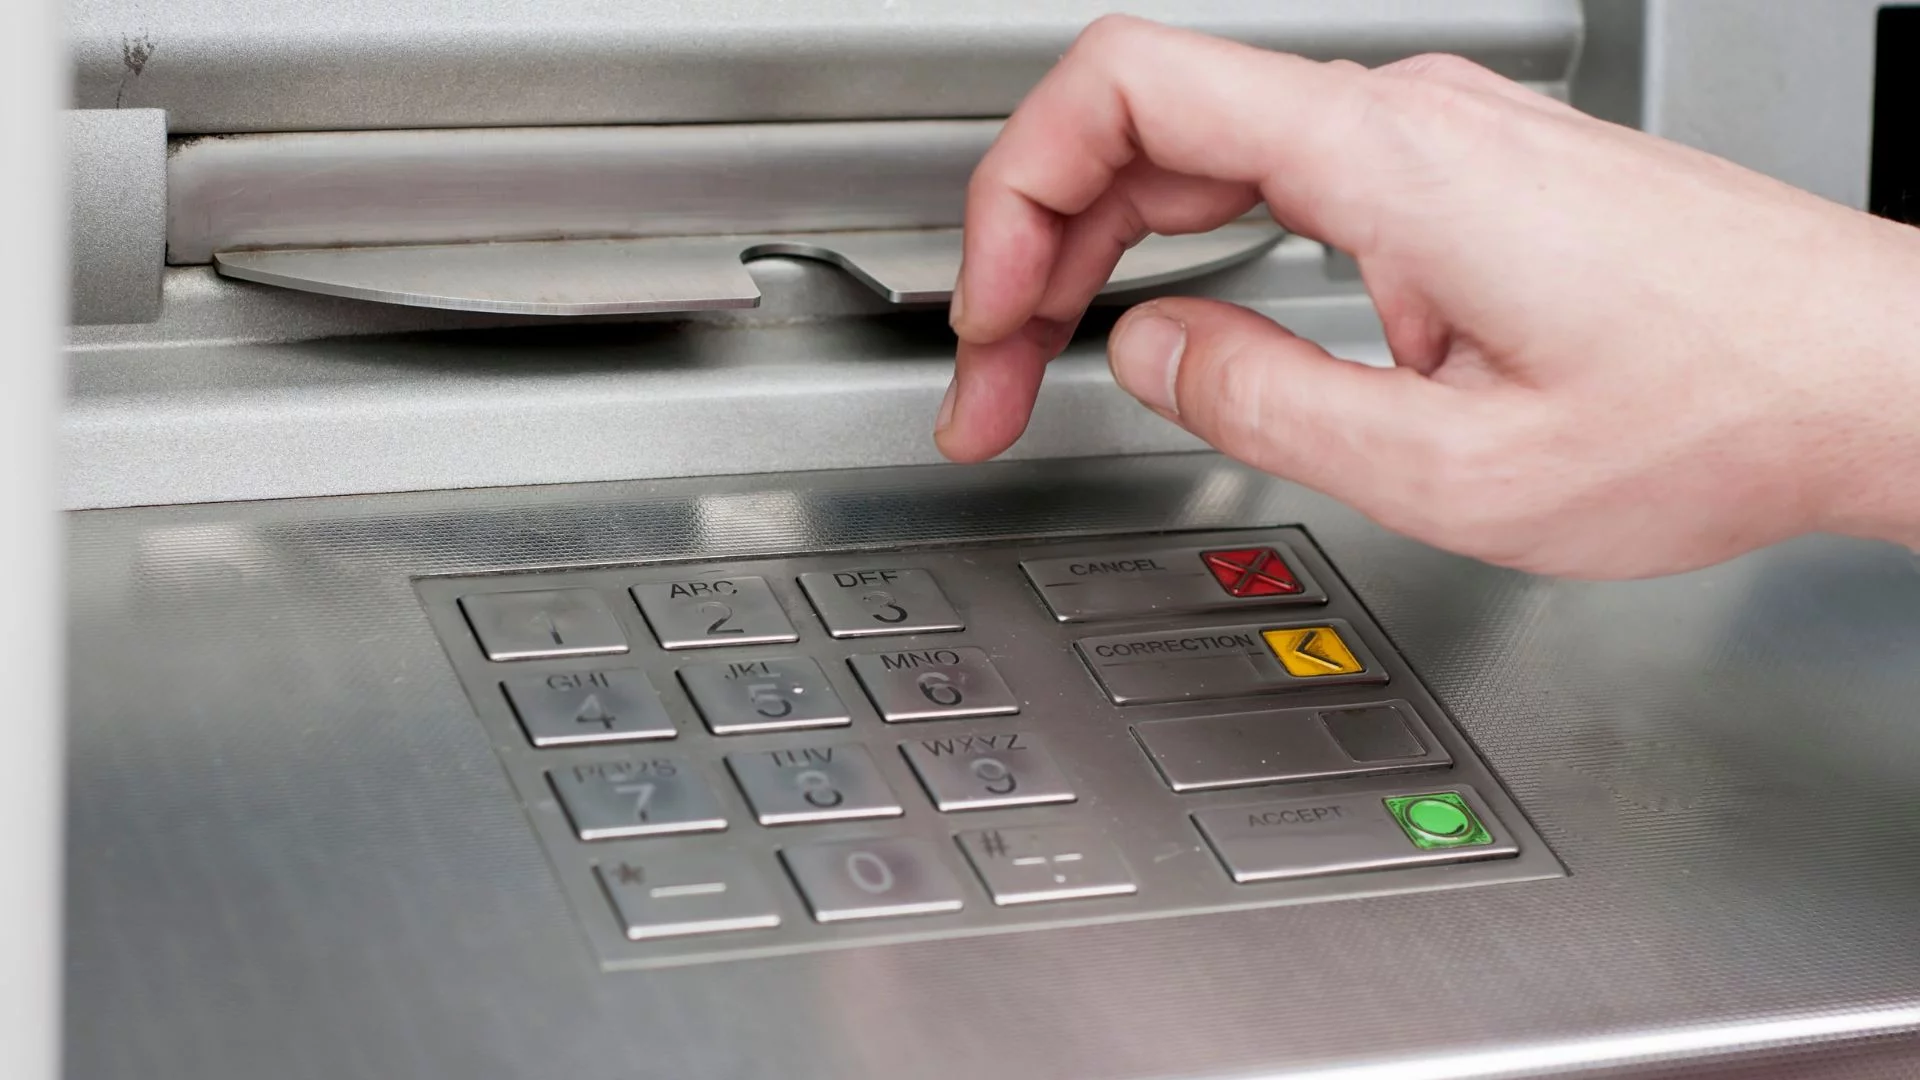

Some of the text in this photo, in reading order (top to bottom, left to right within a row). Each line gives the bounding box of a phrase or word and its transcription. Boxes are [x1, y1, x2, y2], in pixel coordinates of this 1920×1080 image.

[1069, 558, 1166, 577] CANCEL
[670, 580, 738, 599] ABC
[700, 601, 745, 635] 2
[862, 590, 908, 624] 3
[880, 650, 960, 671] MNO
[1094, 633, 1255, 659] CORRECTION
[546, 672, 610, 690] GHI
[918, 672, 962, 706] 6
[575, 693, 616, 730] 4
[747, 684, 792, 718] 5
[922, 734, 1027, 757] WXYZ
[797, 770, 843, 808] 8
[971, 757, 1017, 795] 9
[614, 782, 656, 823] 7
[1247, 805, 1344, 828] ACCEPT
